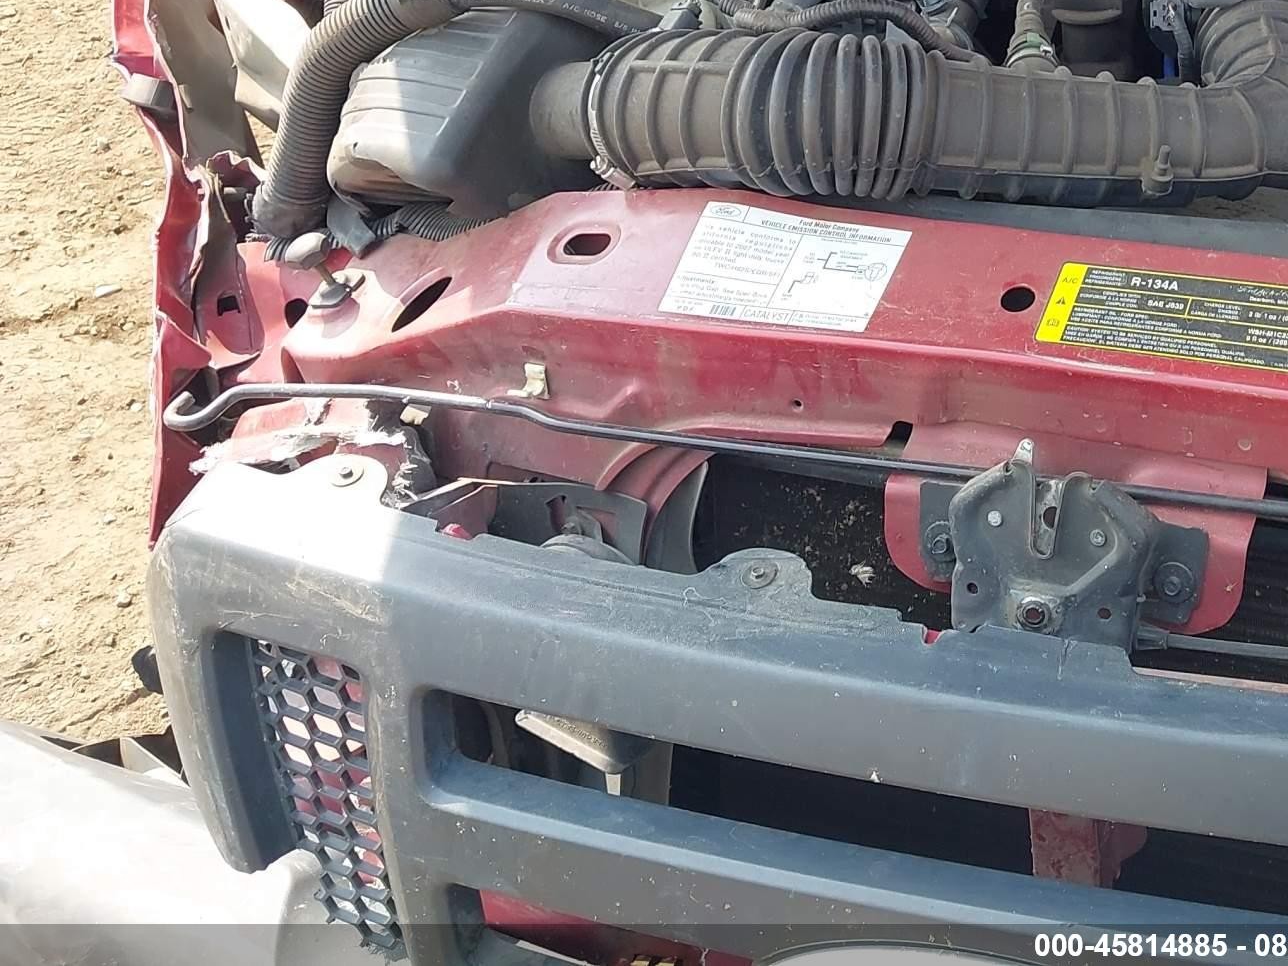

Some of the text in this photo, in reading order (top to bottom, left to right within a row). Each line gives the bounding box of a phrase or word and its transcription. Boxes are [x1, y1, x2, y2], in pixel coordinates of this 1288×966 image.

[761, 220, 787, 231] VEHICLE
[787, 224, 819, 235] EMISSION
[818, 229, 848, 239] CONTROL
[848, 232, 892, 243] INFORMATION
[799, 219, 859, 233] Ford Motor Company
[1062, 276, 1078, 285] A/C
[1129, 276, 1180, 291] R-134A
[1146, 299, 1164, 307] SAE
[744, 306, 790, 322] CATALYST
